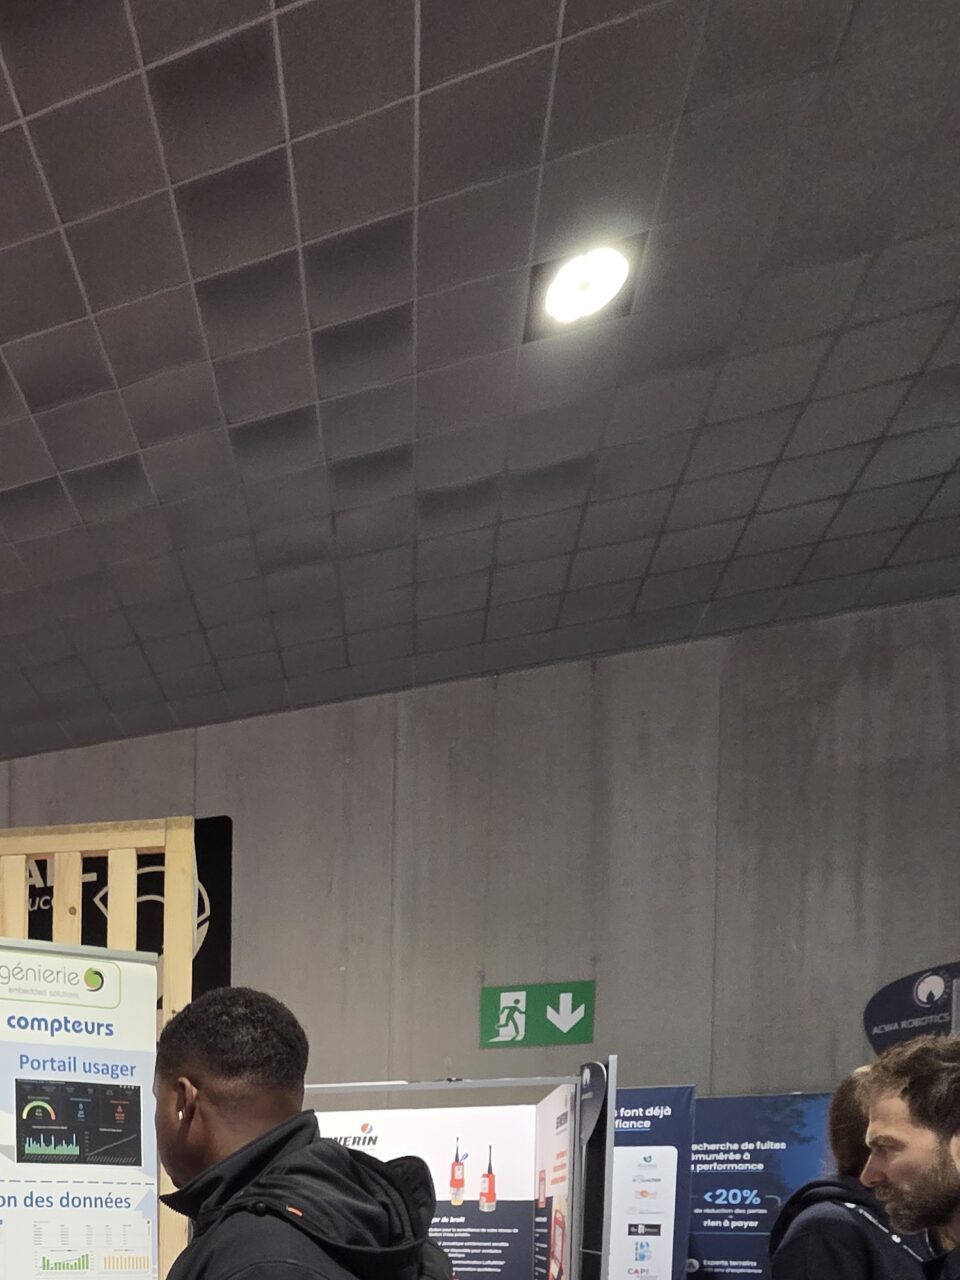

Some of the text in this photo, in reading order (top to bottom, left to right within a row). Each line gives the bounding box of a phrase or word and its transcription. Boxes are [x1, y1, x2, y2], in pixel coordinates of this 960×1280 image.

[7, 1015, 114, 1037] compteurs
[19, 1054, 136, 1080] Portail usager
[620, 1107, 644, 1117] font
[645, 1105, 672, 1119] déjà
[741, 1141, 755, 1150] de
[756, 1140, 786, 1150] fuites
[743, 1152, 751, 1160] à
[696, 1162, 764, 1173] performance
[24, 1191, 54, 1208] des
[59, 1192, 131, 1209] données
[703, 1188, 761, 1205] <20%
[703, 1219, 759, 1229] rien à payer
